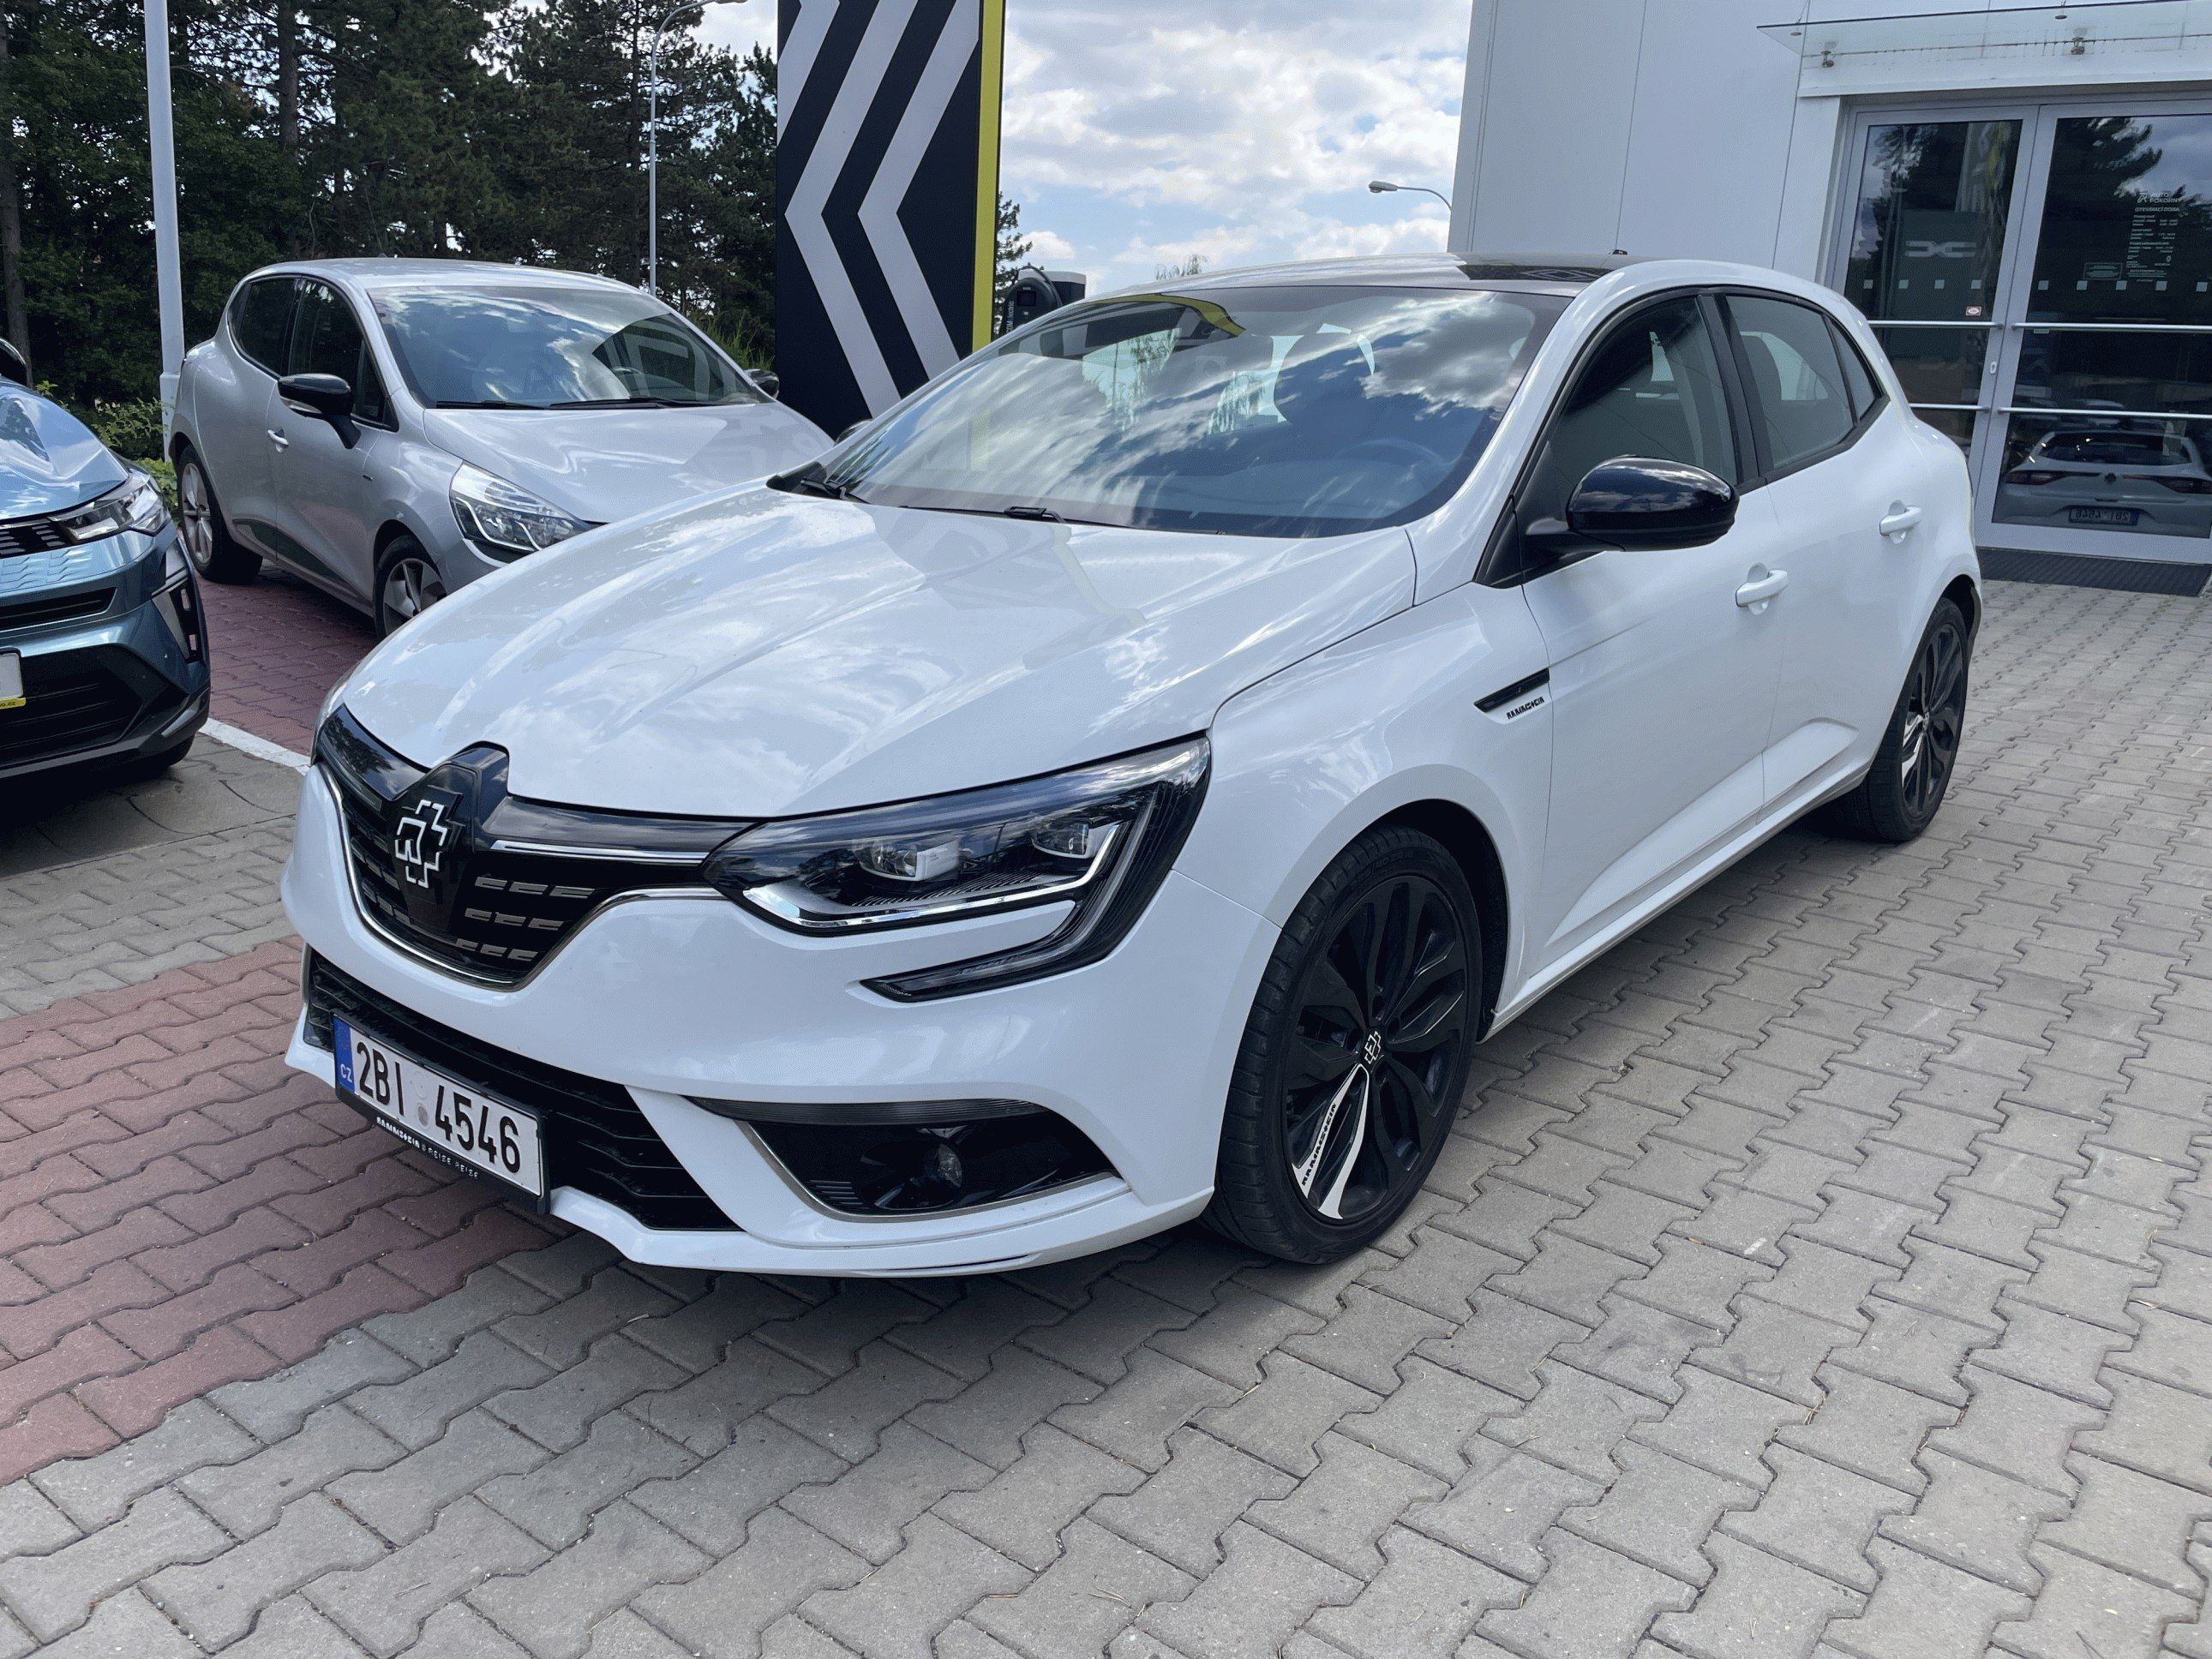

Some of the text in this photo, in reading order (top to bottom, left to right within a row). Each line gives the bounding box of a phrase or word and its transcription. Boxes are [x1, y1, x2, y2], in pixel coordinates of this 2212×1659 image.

[340, 1063, 352, 1083] CZ
[357, 1041, 521, 1174] 2BI 4546
